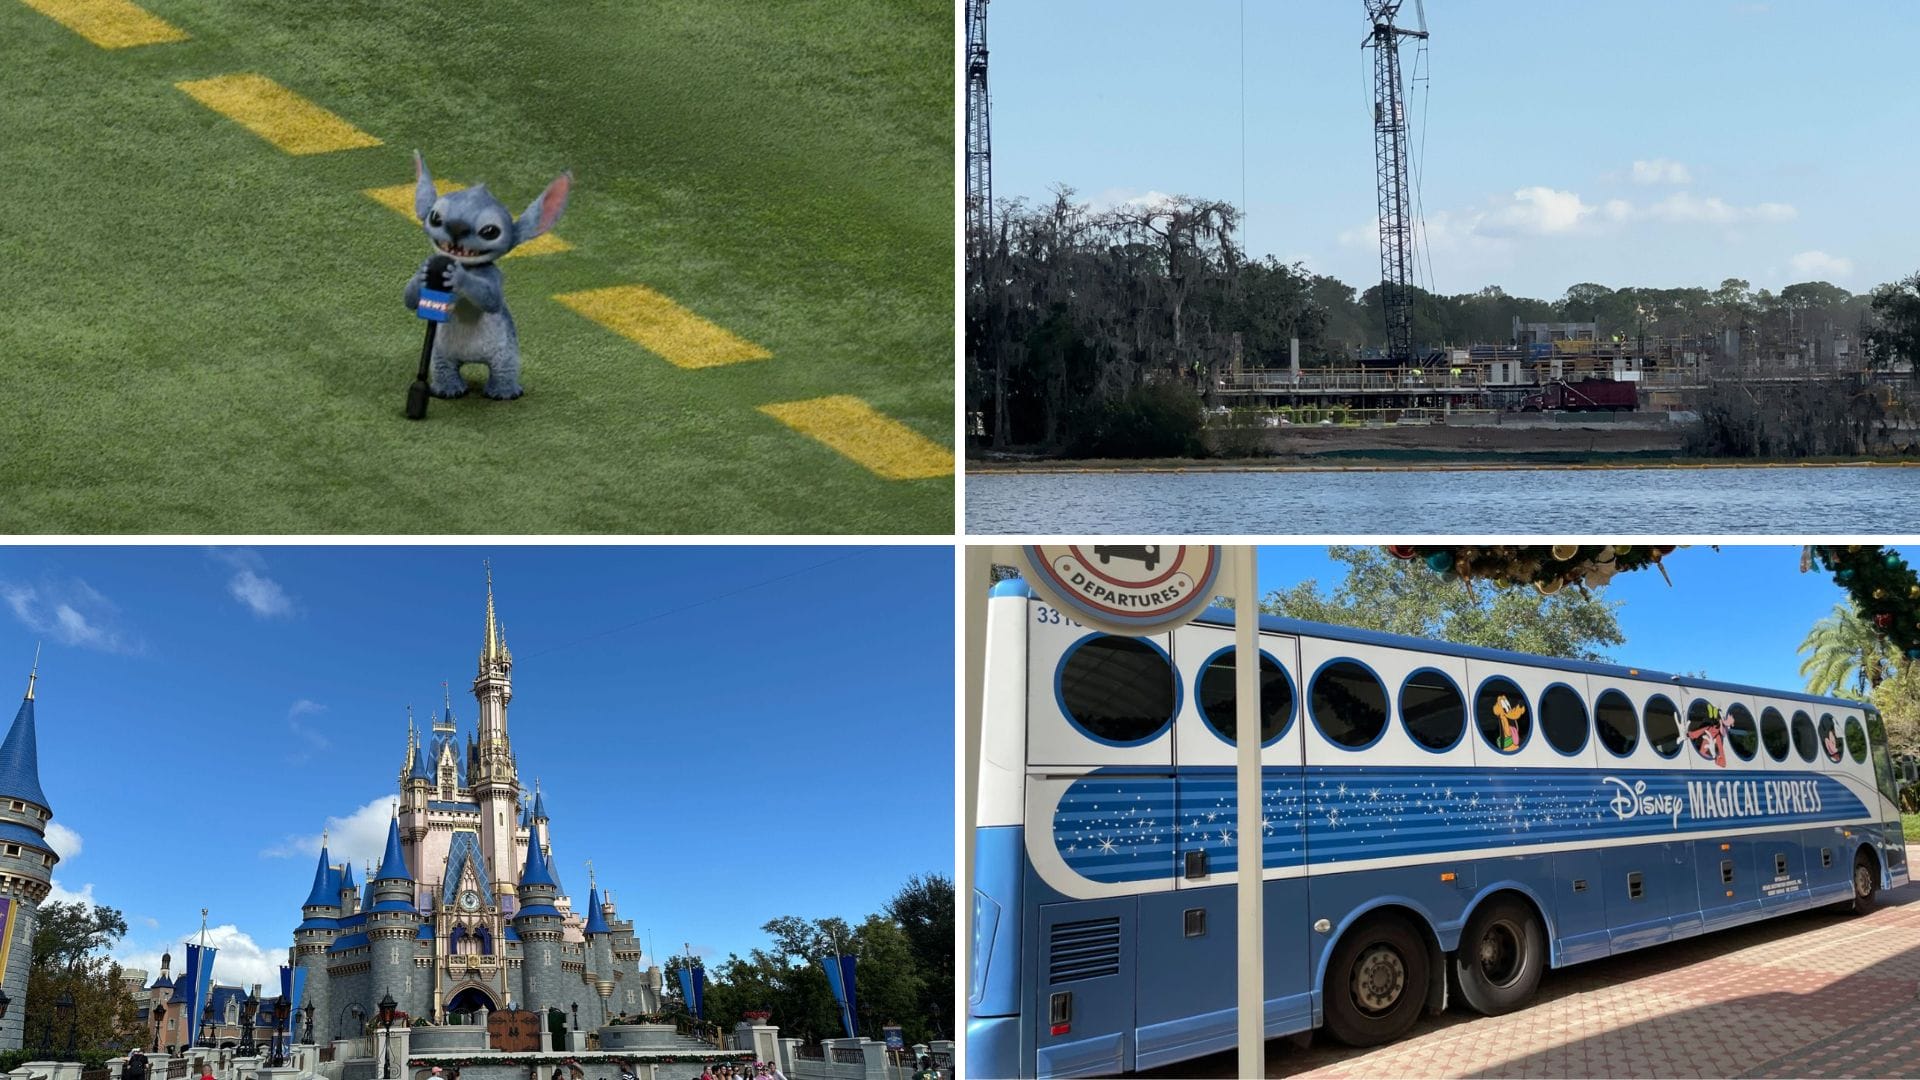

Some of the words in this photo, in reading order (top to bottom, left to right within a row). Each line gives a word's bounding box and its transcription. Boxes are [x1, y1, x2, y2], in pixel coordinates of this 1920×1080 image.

[419, 299, 449, 312] NEWS
[1070, 572, 1180, 607] DEPARTURES
[1687, 780, 1763, 819] MAGICAL
[1764, 780, 1822, 815] EXPRESS
